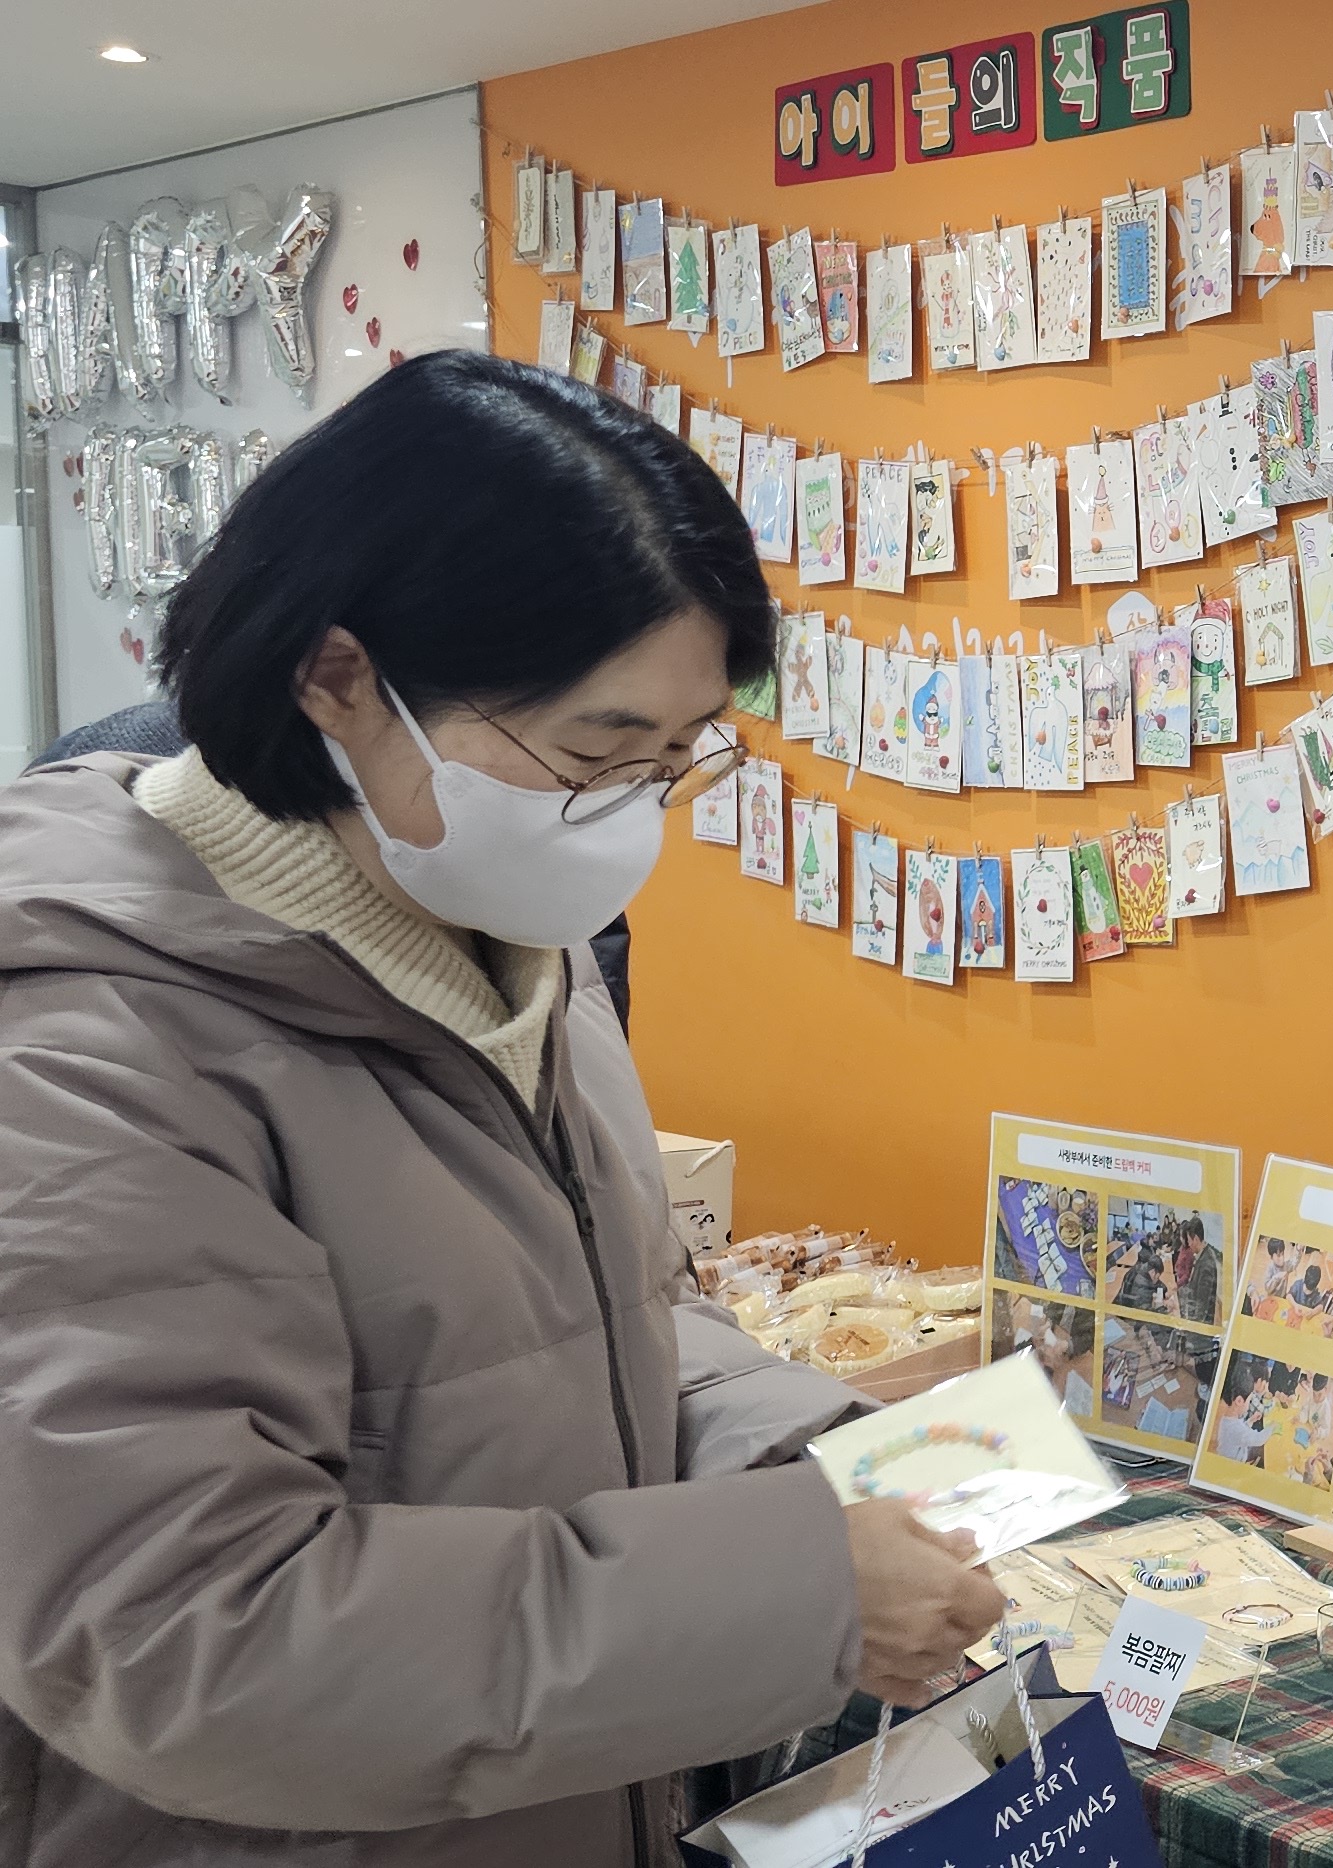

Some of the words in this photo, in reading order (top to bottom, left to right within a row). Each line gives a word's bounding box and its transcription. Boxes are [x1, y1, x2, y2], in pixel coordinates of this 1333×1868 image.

[778, 50, 1017, 167] 아이들의
[865, 464, 904, 483] PEACE
[1298, 522, 1321, 569] JOY
[1025, 656, 1041, 702] JOY
[1066, 714, 1079, 785] PEACE
[1237, 766, 1280, 785] CHRISTMAS
[1058, 1148, 1091, 1167] 사랑부에서
[1091, 1154, 1113, 1169] 준비한
[1136, 1161, 1152, 1175] 커피
[1121, 1632, 1187, 1681] 복음팔찌
[1102, 1680, 1166, 1729] 5,000원
[994, 1756, 1080, 1838] MERRY
[1000, 1784, 1117, 1868] HRISTMAS
